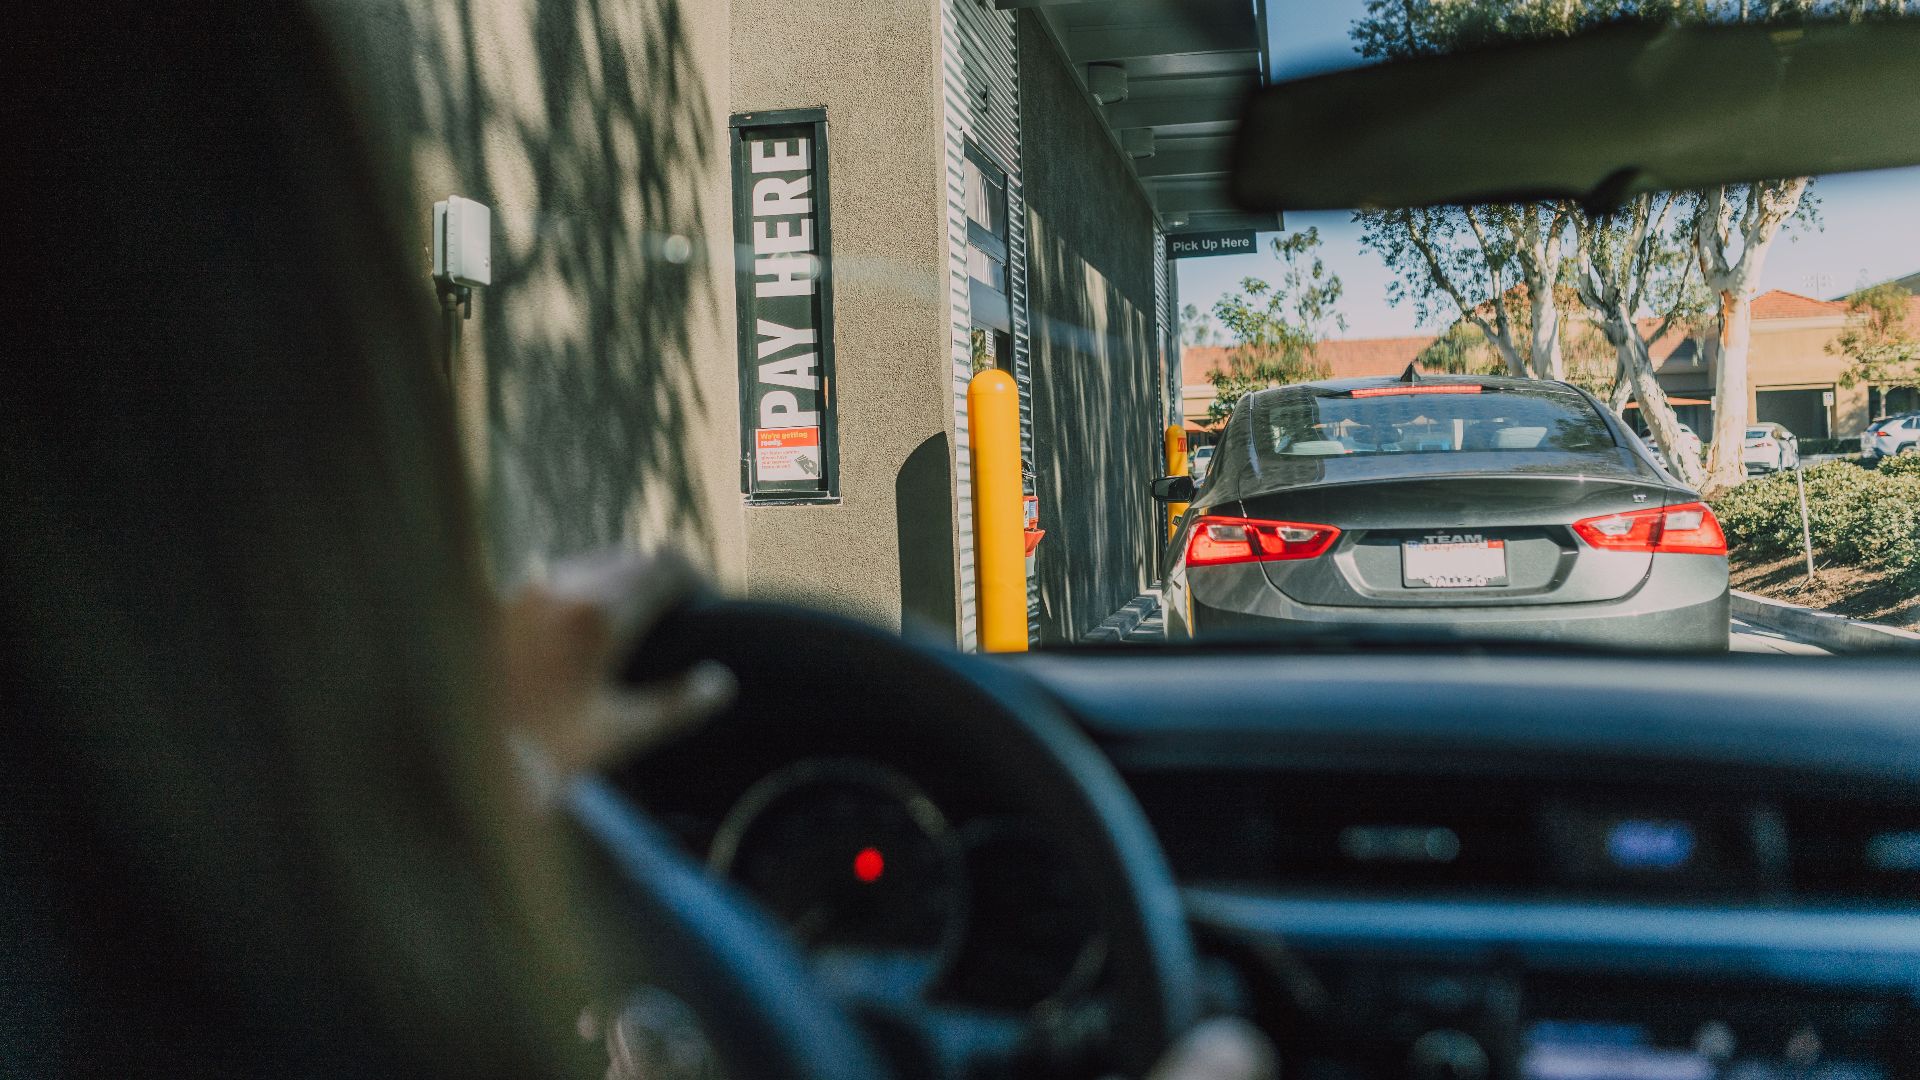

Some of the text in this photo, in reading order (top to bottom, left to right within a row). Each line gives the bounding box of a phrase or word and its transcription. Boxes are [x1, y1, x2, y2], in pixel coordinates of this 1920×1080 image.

[751, 137, 816, 298] HERE
[1173, 238, 1249, 252] Pick Up Here
[757, 318, 820, 428] PAY
[782, 431, 808, 440] getting
[1424, 535, 1483, 544] TEAM
